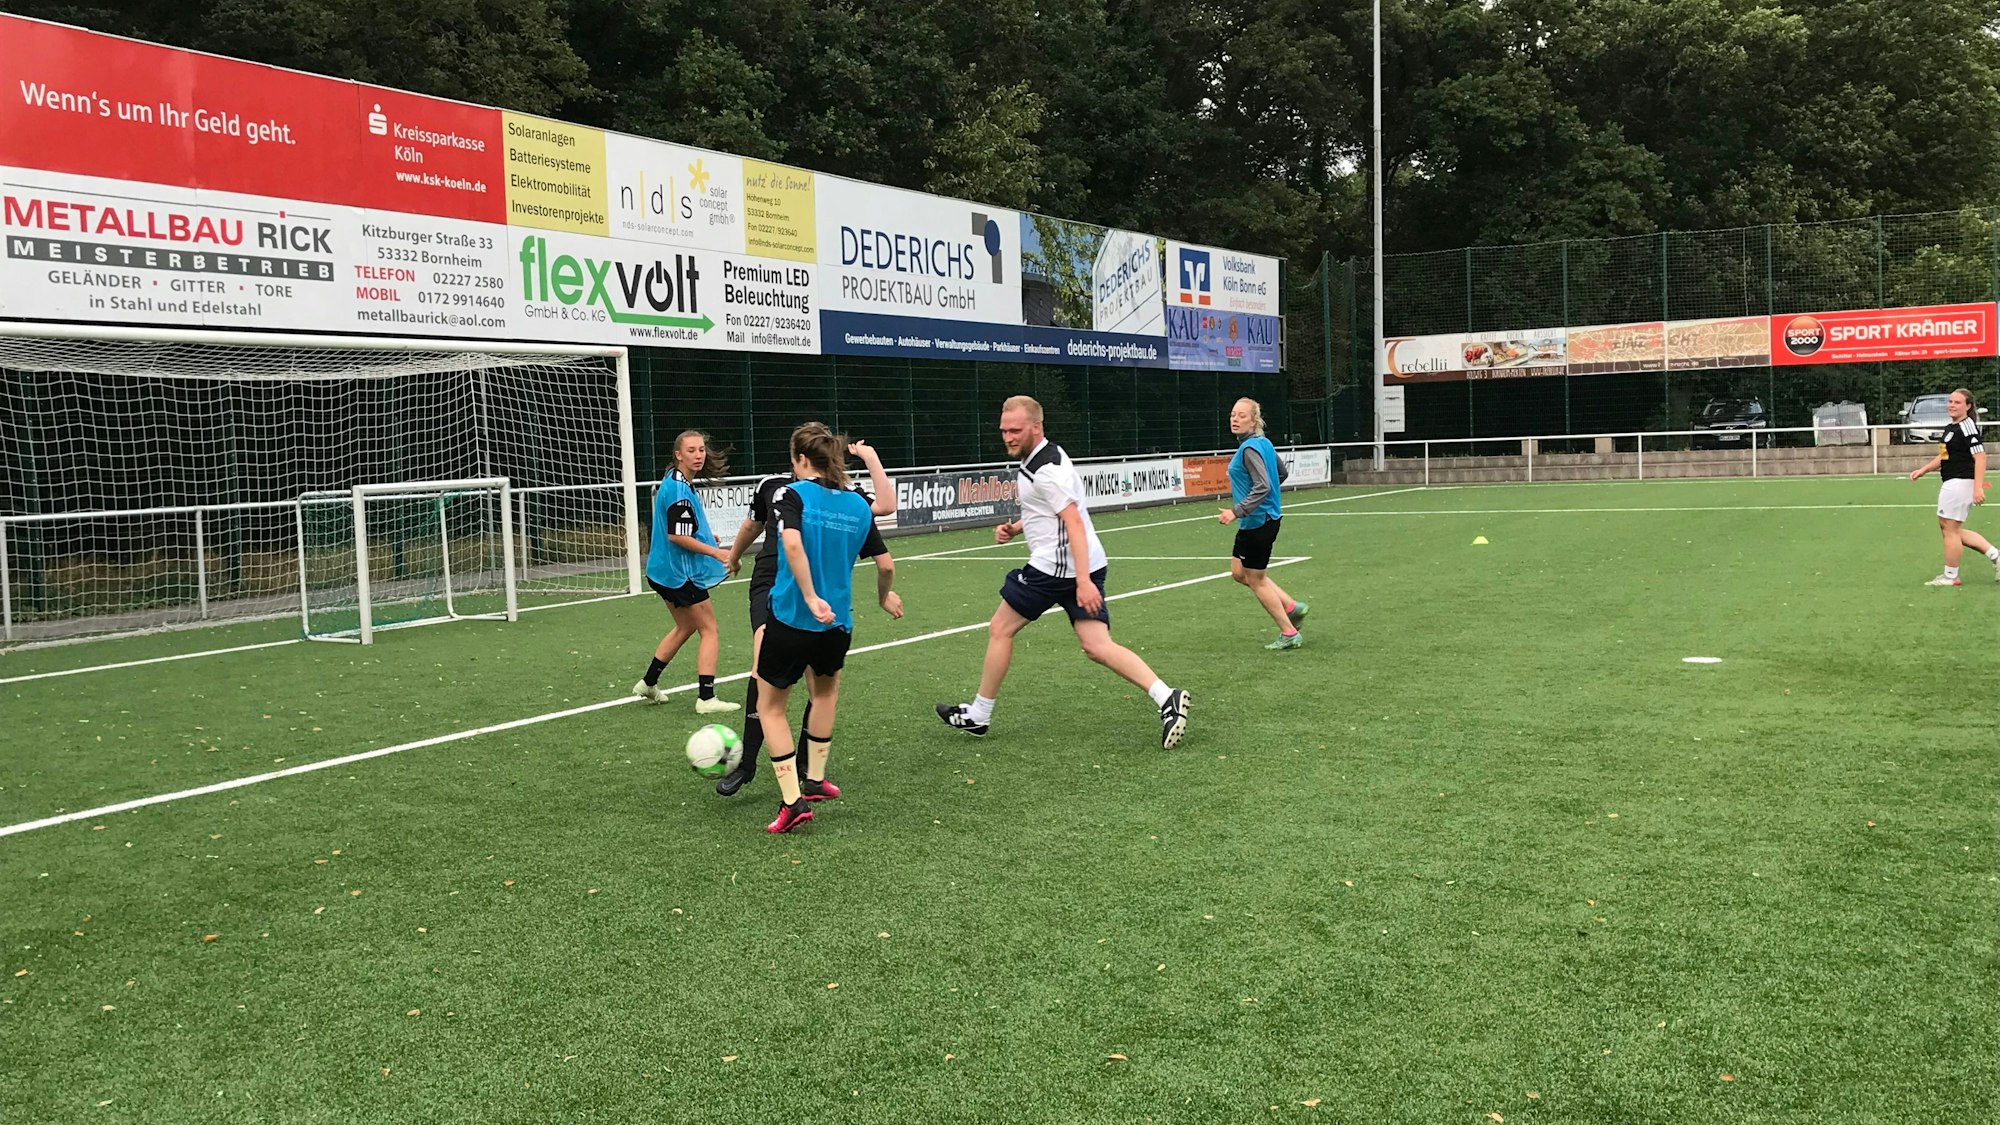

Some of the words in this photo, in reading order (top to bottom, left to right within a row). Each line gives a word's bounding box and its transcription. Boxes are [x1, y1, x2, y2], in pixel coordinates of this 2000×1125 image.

[20, 80, 111, 116] Wenn's
[118, 101, 153, 123] um
[160, 103, 190, 128] Ihr
[195, 109, 241, 136] Geld
[246, 120, 297, 145] geht.
[393, 122, 486, 152] Kreissparkasse
[508, 121, 576, 148] Solaranlagen
[394, 144, 424, 165] Köln
[509, 148, 591, 175] Batteriesysteme
[395, 170, 488, 193] www.ksk-koeln.de
[511, 174, 591, 199] Elektromobilität
[709, 184, 728, 200] solar
[769, 172, 784, 190] die
[785, 174, 812, 192] Sonne!
[511, 200, 605, 226] Investorenprojekte
[699, 196, 729, 213] concept
[774, 197, 782, 206] 10
[4, 195, 244, 246] METALLBAU
[747, 207, 765, 218] 53332
[765, 210, 790, 222] Bornheim
[362, 223, 432, 248] Kitzburger
[436, 229, 476, 249] Straße
[478, 234, 494, 250] 33
[621, 218, 695, 239] nds-solarconcept.com
[747, 222, 758, 231] Fon
[758, 224, 798, 238] 02227/923640
[13, 239, 330, 279] MEISTERBETRIEB
[377, 245, 418, 264] 53332
[421, 249, 483, 269] Bornheim
[841, 225, 975, 281] DEDERICHS
[355, 265, 417, 283] TELEFON
[433, 271, 471, 289] 02227
[472, 275, 504, 290] 2580
[519, 235, 699, 314] flexvolt
[723, 260, 783, 285] Premium
[786, 266, 810, 287] LED
[1099, 239, 1151, 303] DEDERICHS
[1223, 256, 1256, 275] Volksbank
[48, 268, 142, 290] GELÄNDER
[170, 278, 226, 294] GITTER
[255, 283, 293, 299] TORE
[842, 274, 934, 307] PROJEKTBAU
[937, 285, 976, 311] GmbH
[1099, 266, 1153, 323] PROJEKTBAU
[1223, 275, 1239, 291] Köln
[1239, 279, 1257, 294] Bonn
[1257, 282, 1267, 296] eG
[89, 295, 106, 311] in
[109, 296, 153, 314] Stahl
[157, 299, 188, 314] und
[192, 300, 263, 317] Edelstahl
[356, 286, 401, 303] MOBIL
[418, 291, 449, 307] 0172
[451, 293, 506, 309] 9914640
[724, 284, 810, 314] Beleuchtung
[357, 307, 506, 329] metallbaurick@aol.com
[524, 304, 558, 321] GmbH
[561, 306, 571, 321] &
[572, 306, 589, 322] Co.
[590, 307, 607, 323] KG
[726, 313, 742, 327] Fon
[743, 314, 811, 332] 02227/9236420
[1168, 308, 1200, 341] KAU
[629, 325, 699, 342] www.flexvolt.de
[726, 330, 745, 344] Mail
[751, 332, 812, 347] info@flexvolt.de
[1247, 317, 1273, 345] KAU
[1788, 327, 1821, 337] SPORT
[1790, 336, 1819, 346] 2000
[1830, 324, 1893, 342] SPORT
[1896, 319, 1978, 339] KRÄMER
[844, 332, 894, 347] Gewerbebauten
[897, 336, 932, 349] Autohäuser
[935, 338, 990, 353] Verwaltungsgebäude
[992, 341, 1021, 354] Parkhäuser
[1023, 343, 1061, 356] Einkaufszentren
[1066, 339, 1158, 361] dederichs-projektbau.de
[1095, 471, 1120, 497] KÖLSCH
[1133, 471, 1148, 493] DOM
[1148, 466, 1170, 491] KÖLSCH
[897, 481, 956, 511] Elektro
[958, 475, 1022, 506] Mahlberg
[932, 504, 995, 521] BORNHEIM-SECHTEM
